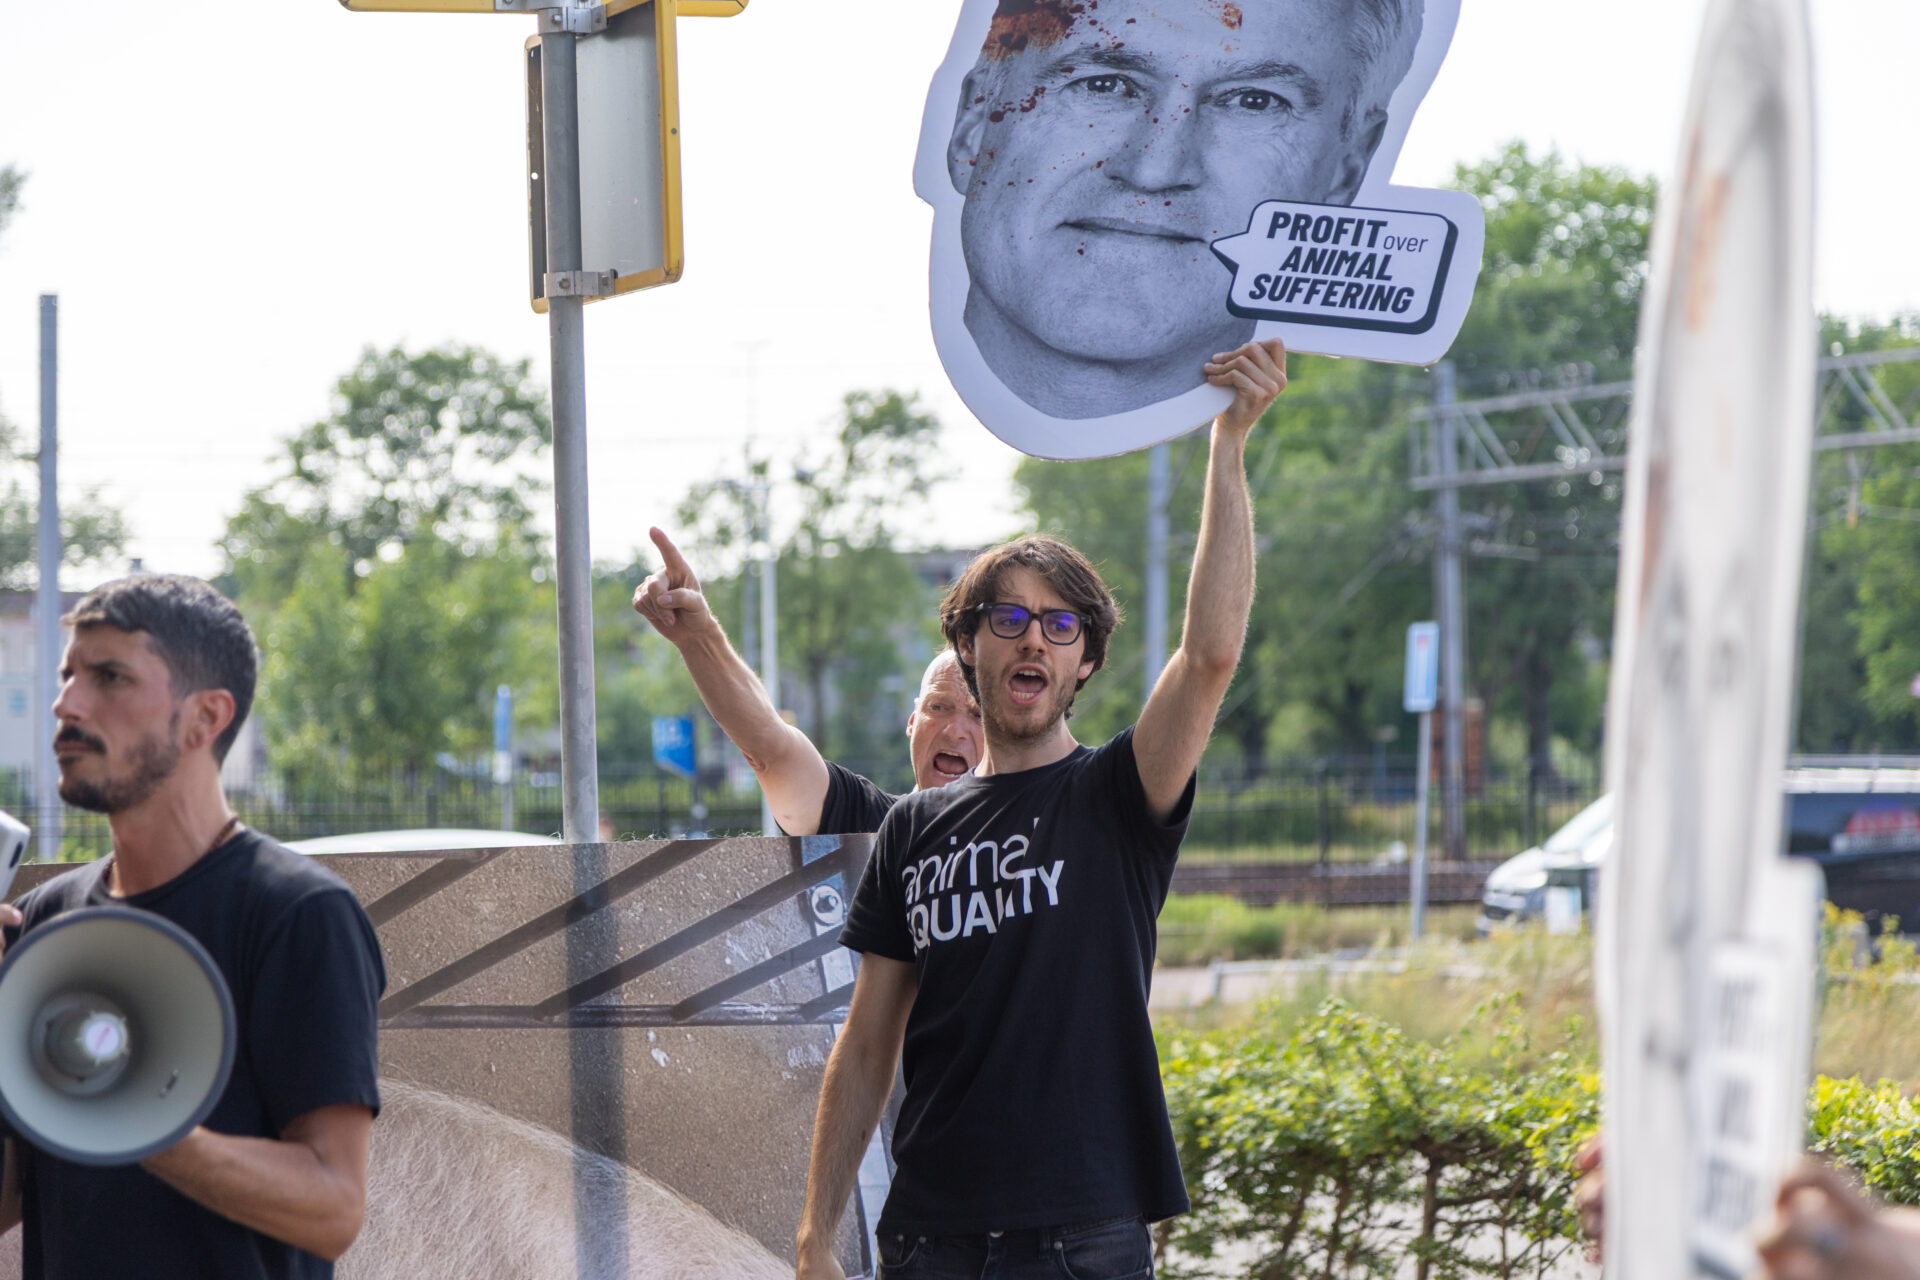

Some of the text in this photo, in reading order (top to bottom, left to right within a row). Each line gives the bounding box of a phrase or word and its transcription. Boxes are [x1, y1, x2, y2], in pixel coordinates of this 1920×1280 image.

[1267, 211, 1428, 252] PROFIT over
[1279, 247, 1392, 281] ANIMAL
[1249, 273, 1415, 314] SUFFERING
[902, 817, 1040, 904] anima
